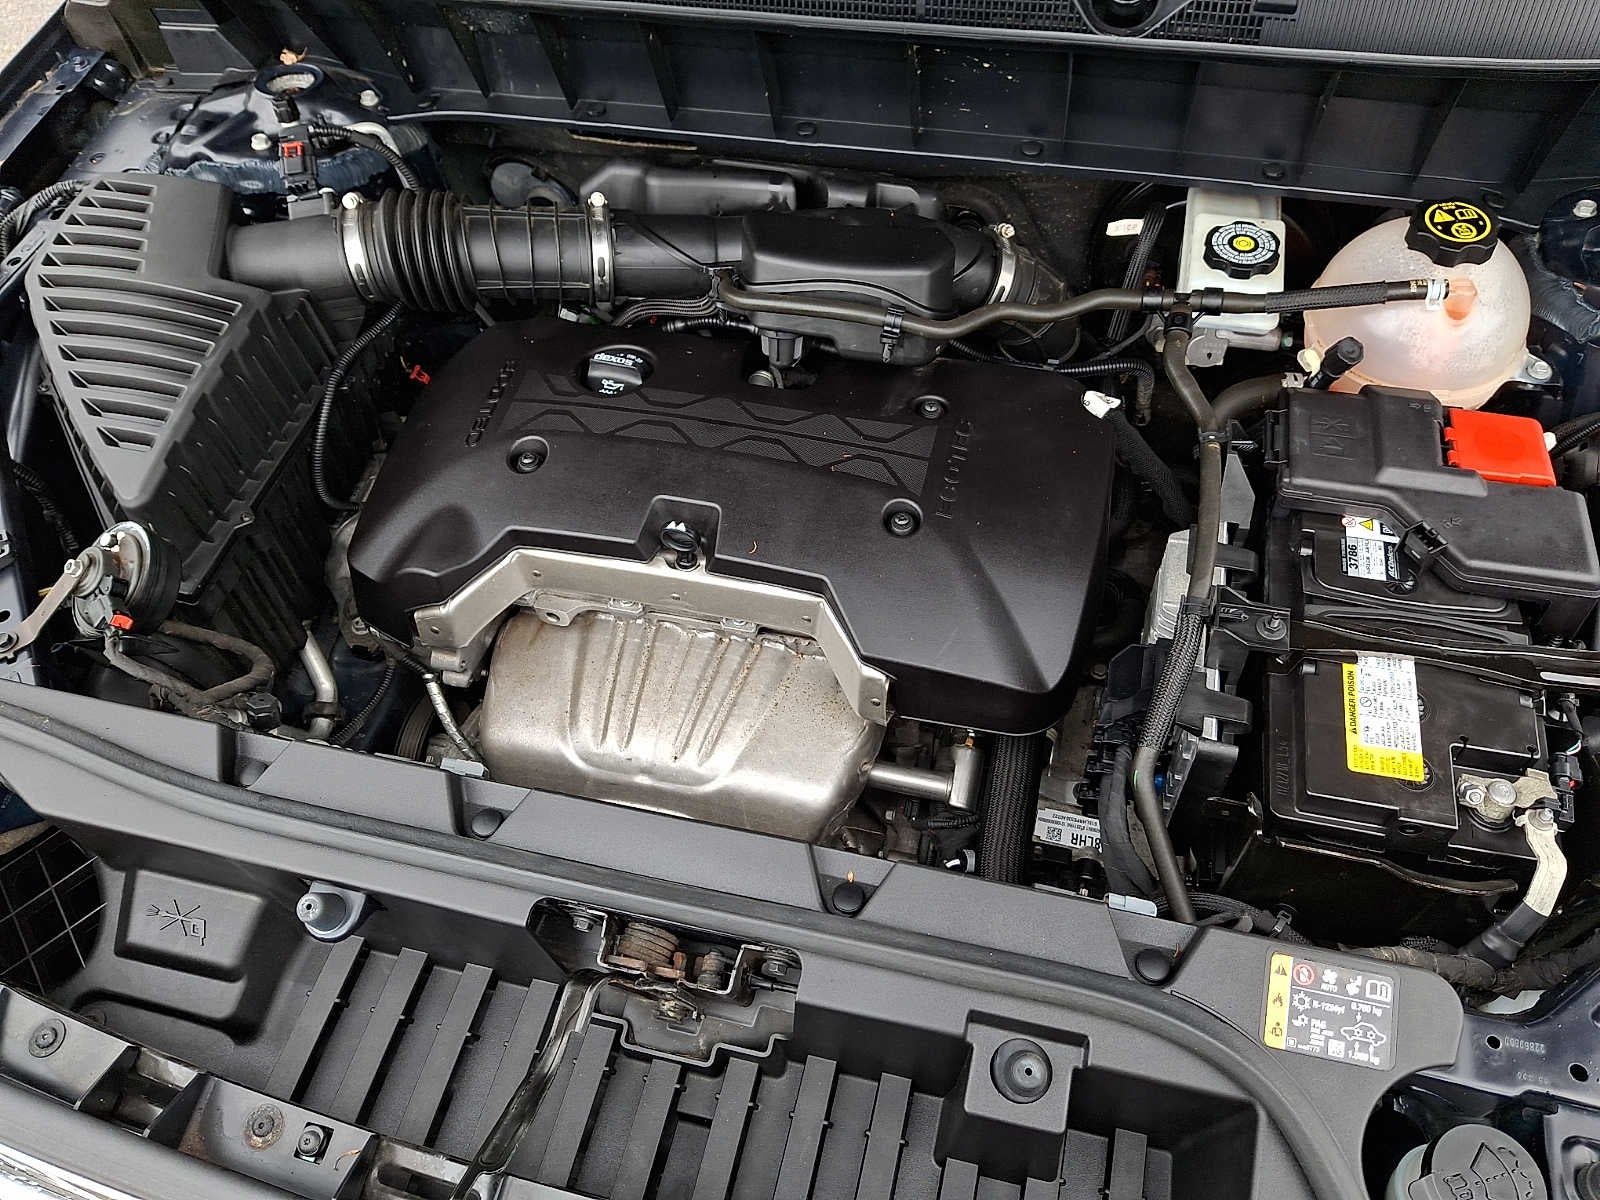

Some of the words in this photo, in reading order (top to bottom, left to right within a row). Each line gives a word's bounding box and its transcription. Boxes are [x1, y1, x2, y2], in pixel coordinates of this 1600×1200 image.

[593, 352, 635, 367] dexos
[1347, 544, 1359, 570] 3786
[1386, 545, 1396, 578] ACDelco
[1346, 670, 1355, 697] POISON
[1347, 698, 1357, 727] DANGER
[1320, 983, 1338, 993] AUTO
